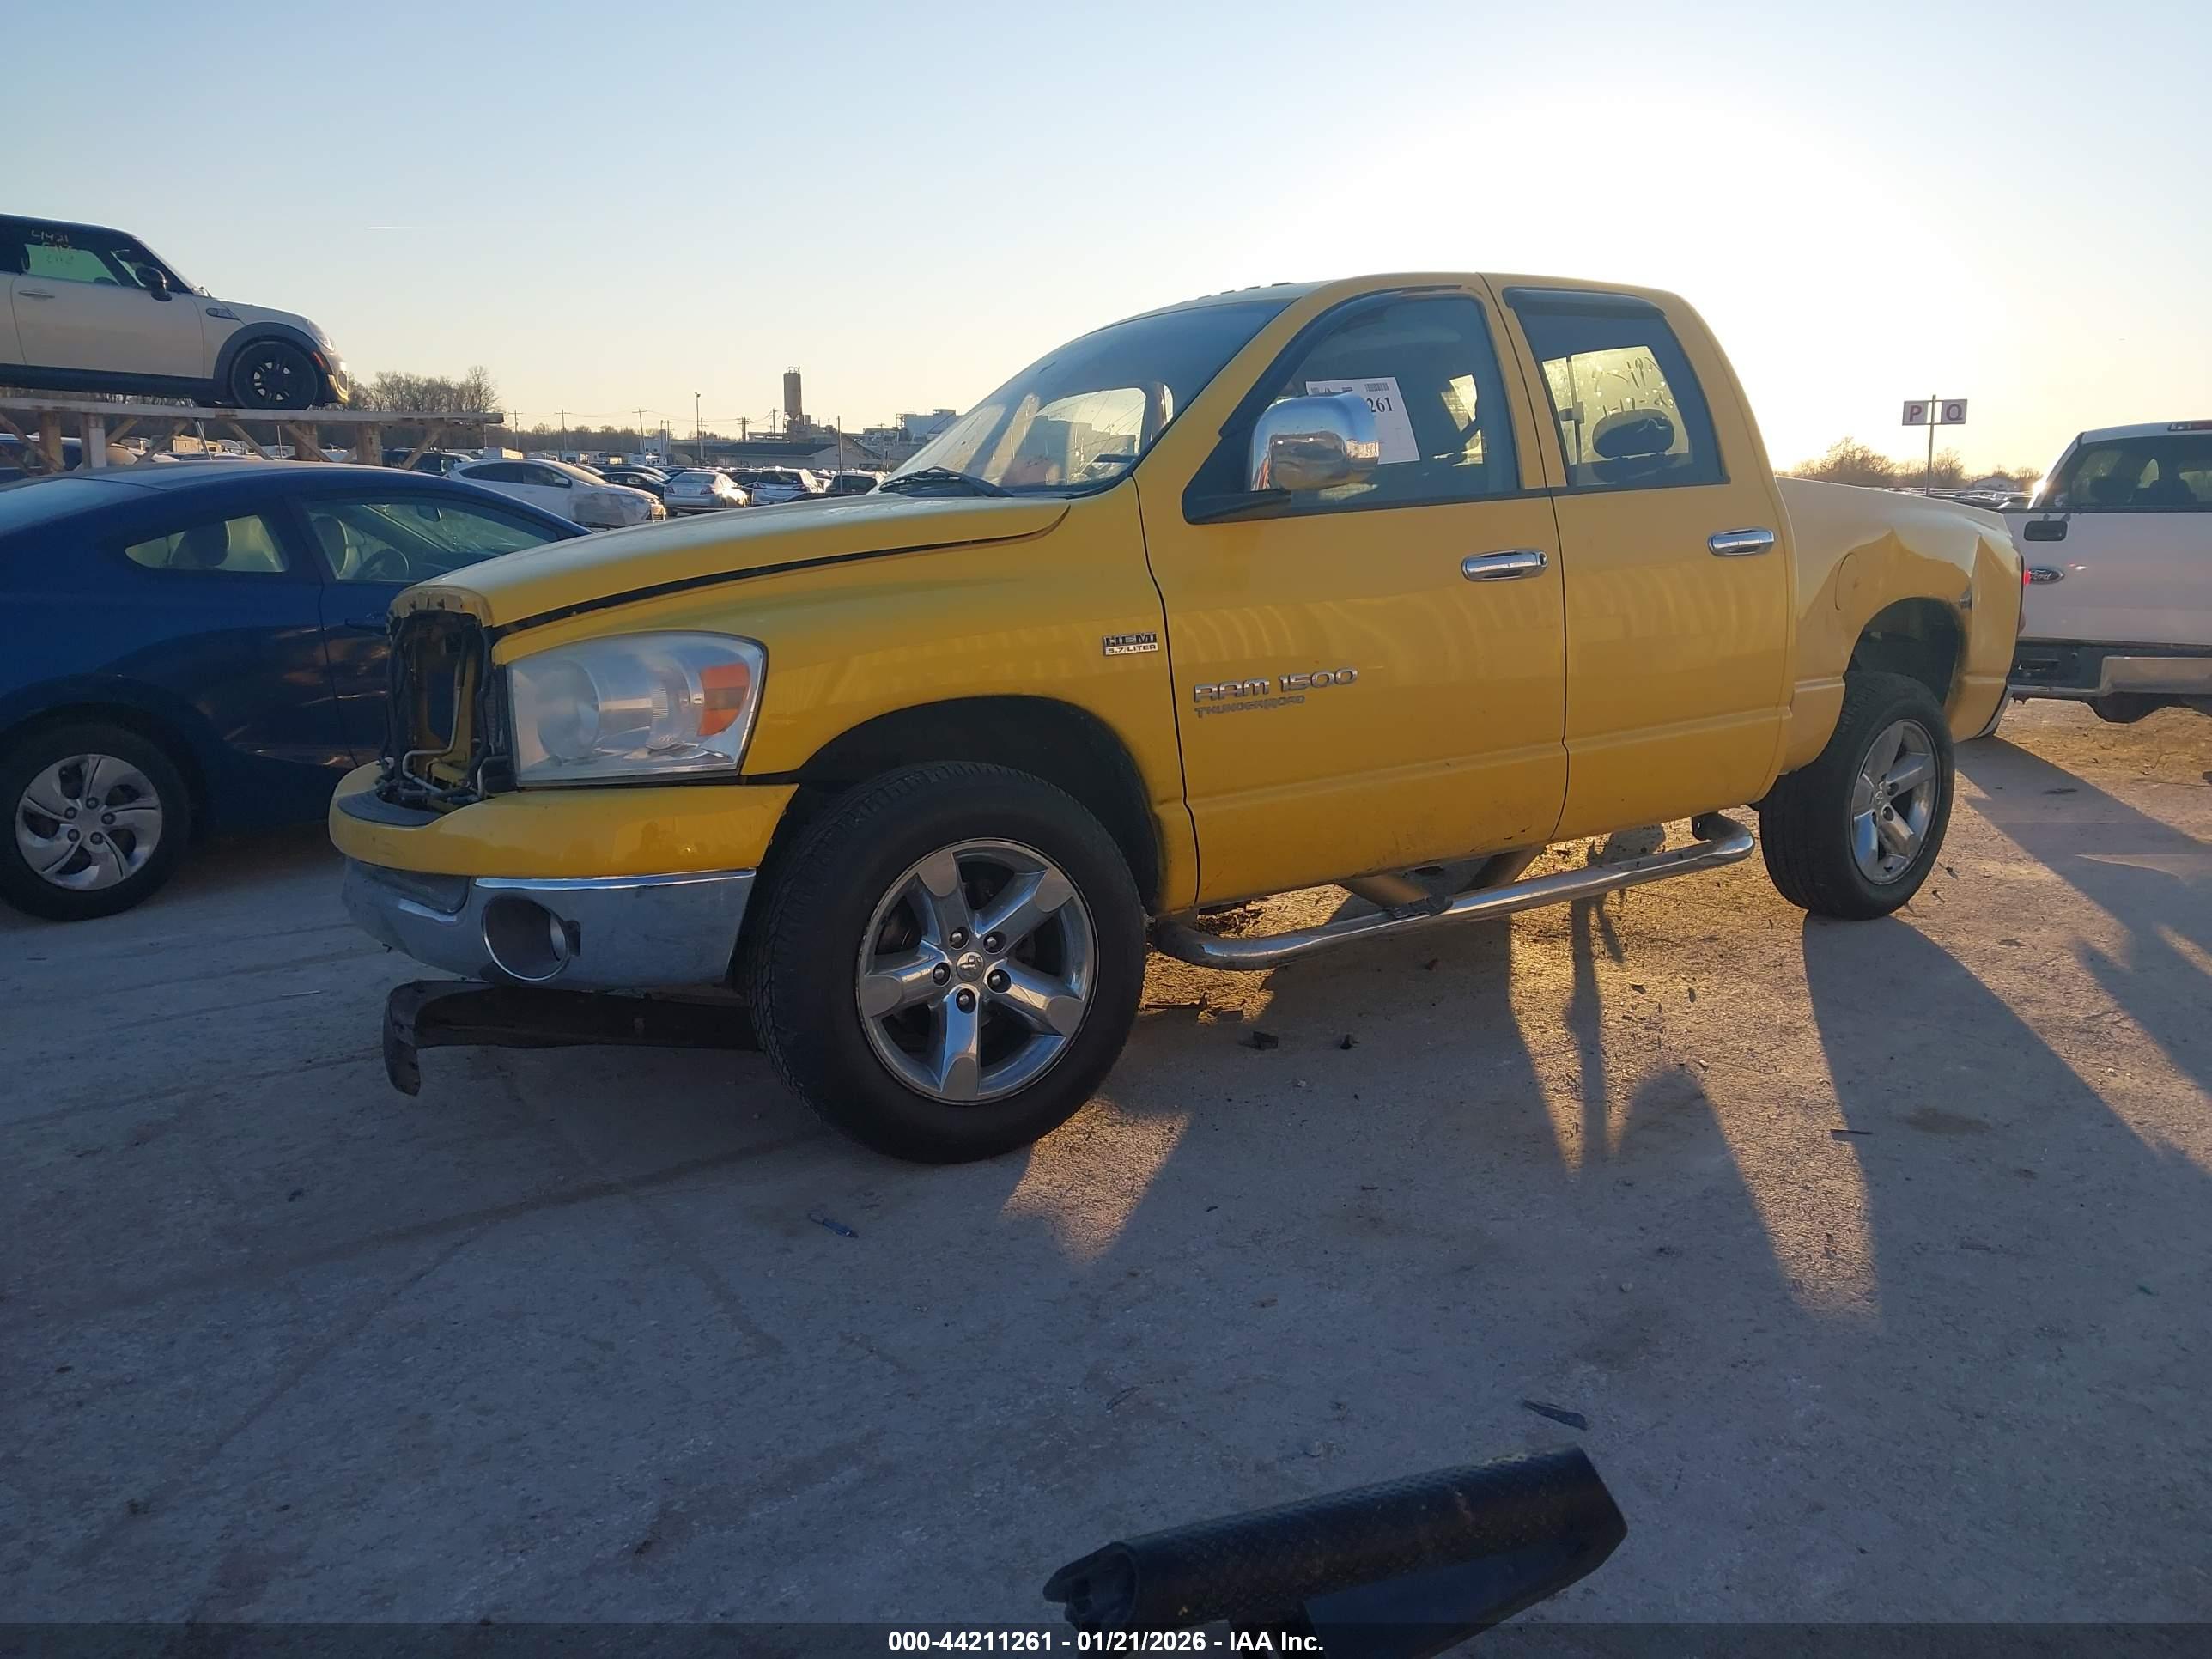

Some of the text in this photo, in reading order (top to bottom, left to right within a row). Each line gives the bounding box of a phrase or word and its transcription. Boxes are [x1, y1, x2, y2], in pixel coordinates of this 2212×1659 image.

[1909, 404, 1923, 422] P
[1946, 404, 1963, 421] Q
[1105, 633, 1157, 647] HEMI
[1127, 643, 1157, 653] LITER
[1194, 666, 1358, 702] RAM 1500
